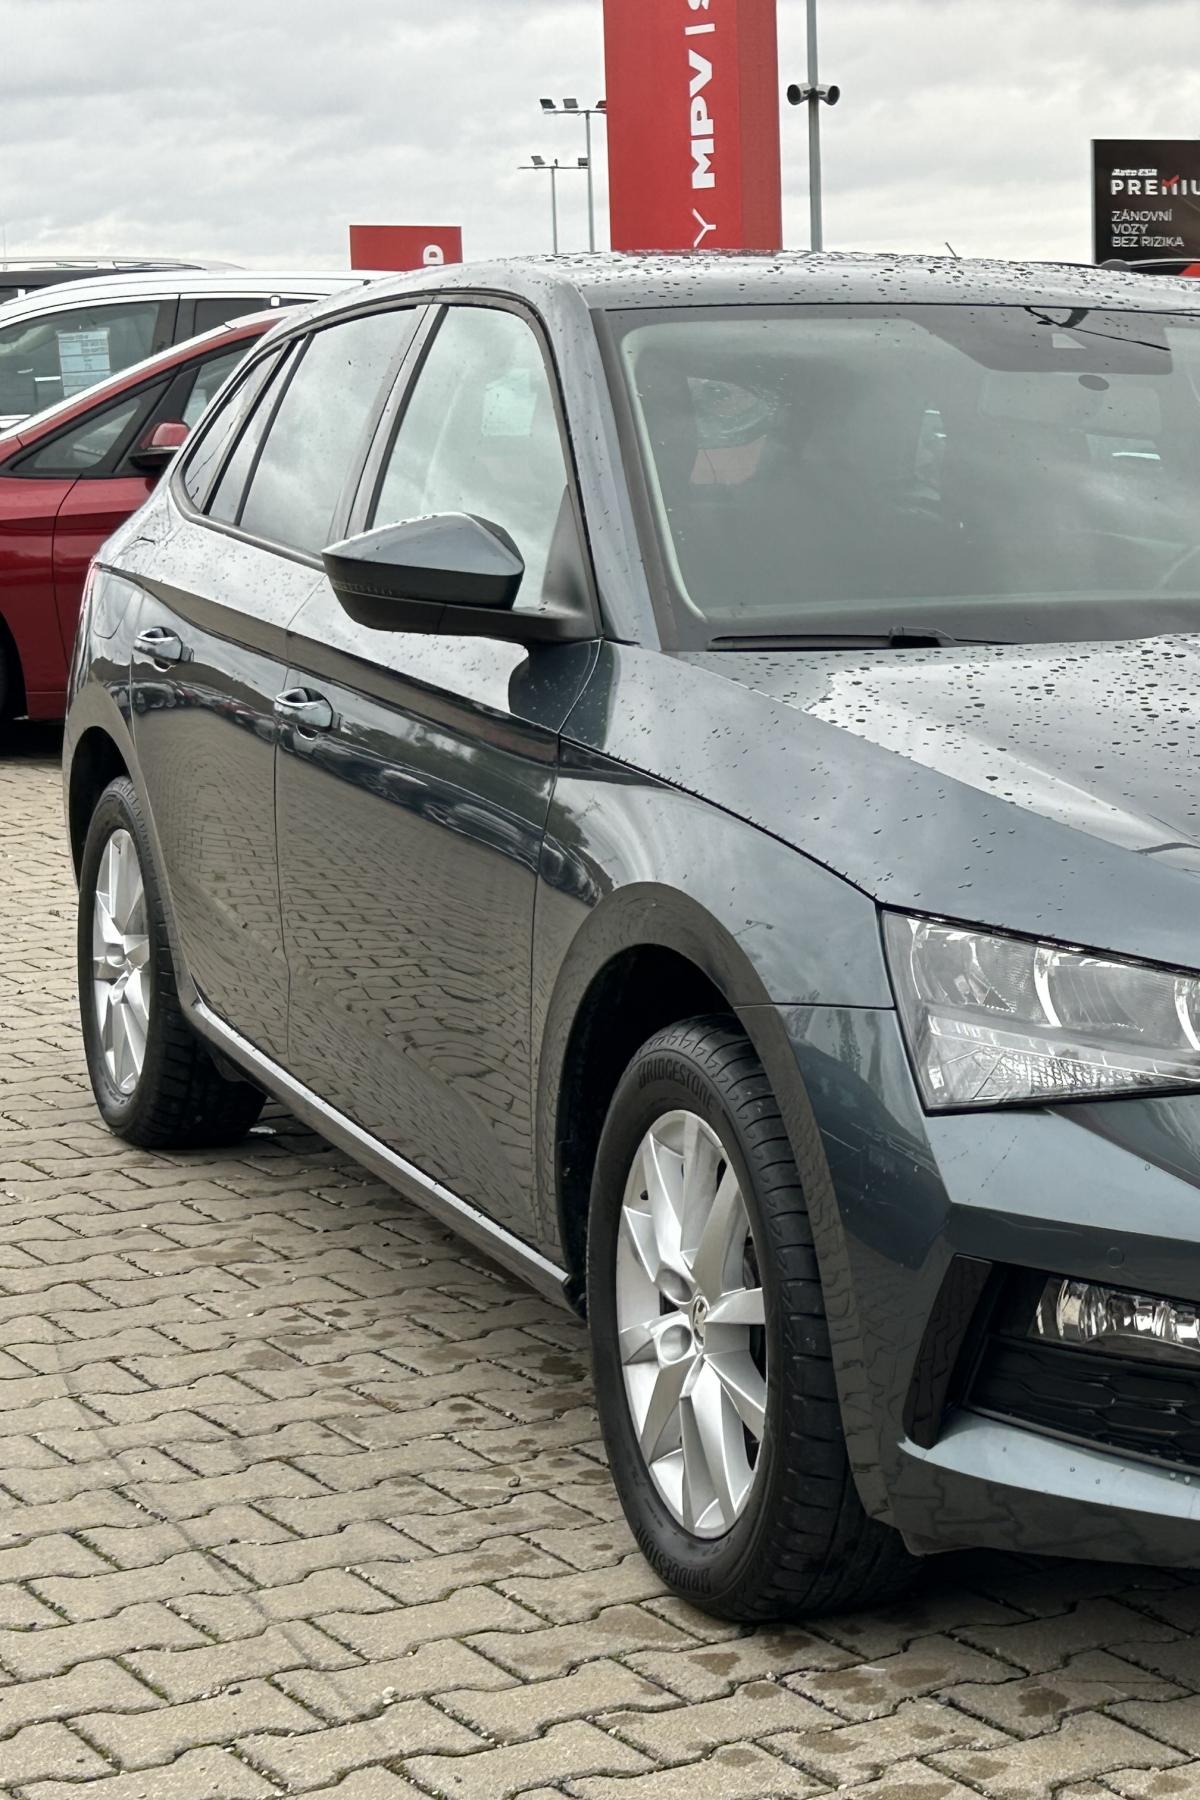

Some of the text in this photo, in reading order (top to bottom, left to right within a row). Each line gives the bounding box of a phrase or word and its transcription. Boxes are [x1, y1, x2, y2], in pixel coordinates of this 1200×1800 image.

[688, 48, 716, 190] MPV
[1111, 209, 1172, 221] ZÁNOVNÍ
[1111, 223, 1149, 234] VOZY
[1111, 236, 1184, 247] BEZ RIZIKA
